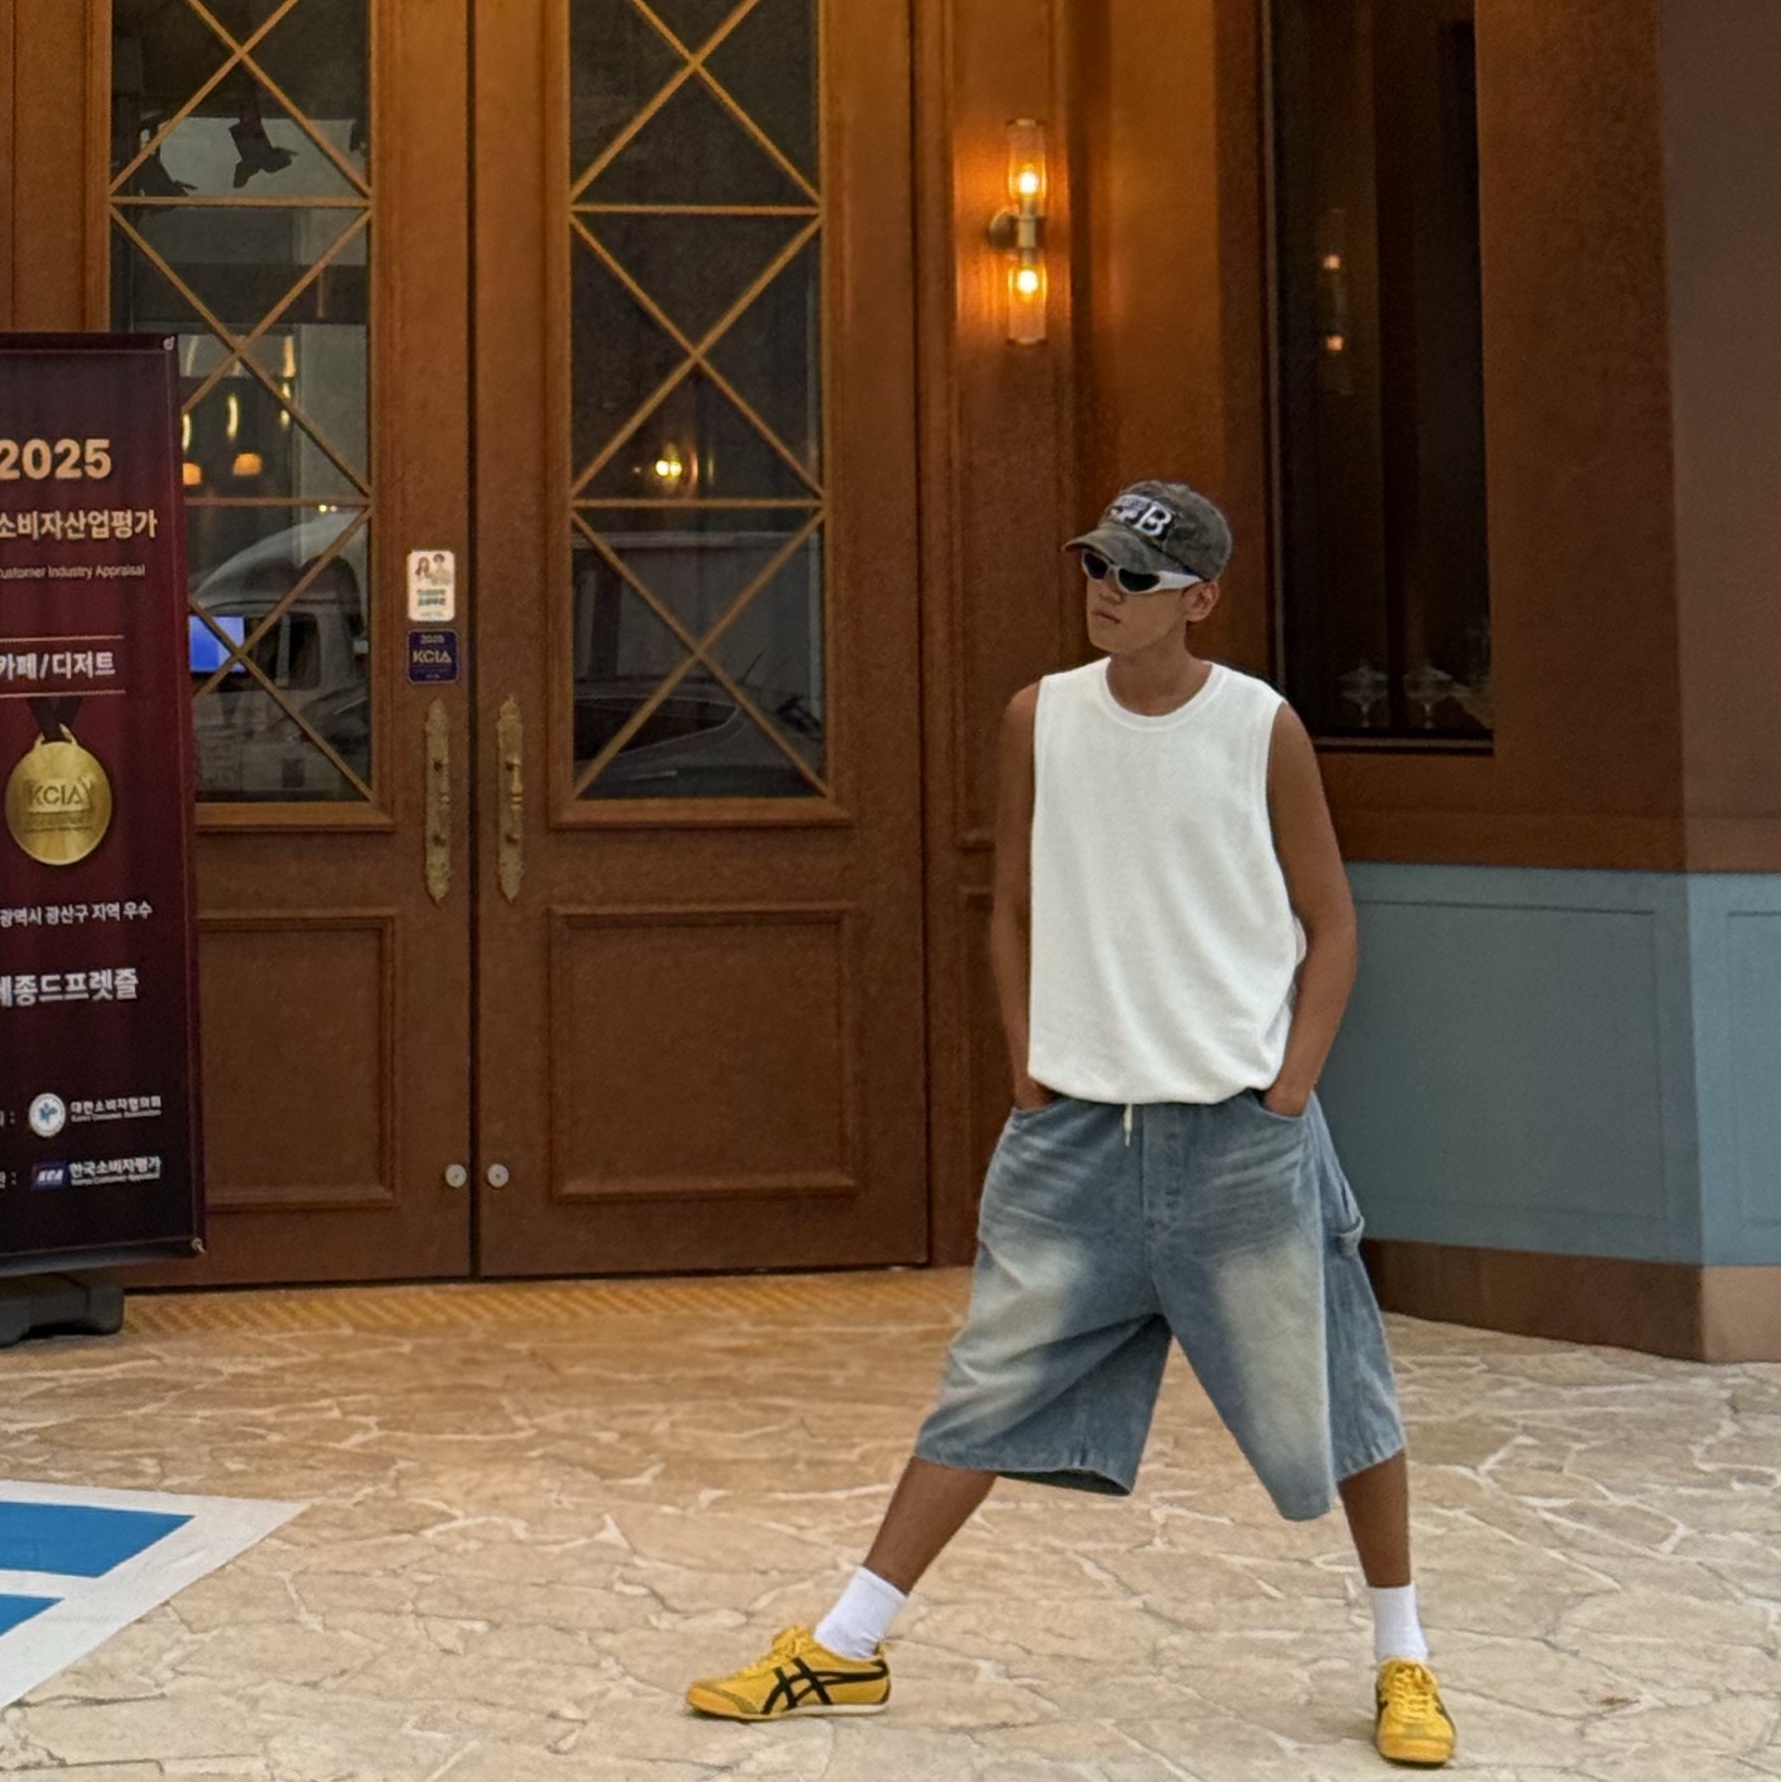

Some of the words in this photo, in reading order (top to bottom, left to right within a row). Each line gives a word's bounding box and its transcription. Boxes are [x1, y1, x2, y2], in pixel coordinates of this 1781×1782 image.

[0, 438, 112, 480] 2025
[0, 508, 158, 541] 소비자산업평가
[48, 565, 93, 581] Industry
[95, 563, 146, 580] Appraisal
[412, 649, 452, 664] KCIA
[28, 784, 85, 806] KCIA
[45, 903, 89, 926] 광산구
[91, 901, 121, 922] 지역
[122, 899, 153, 920] 우수
